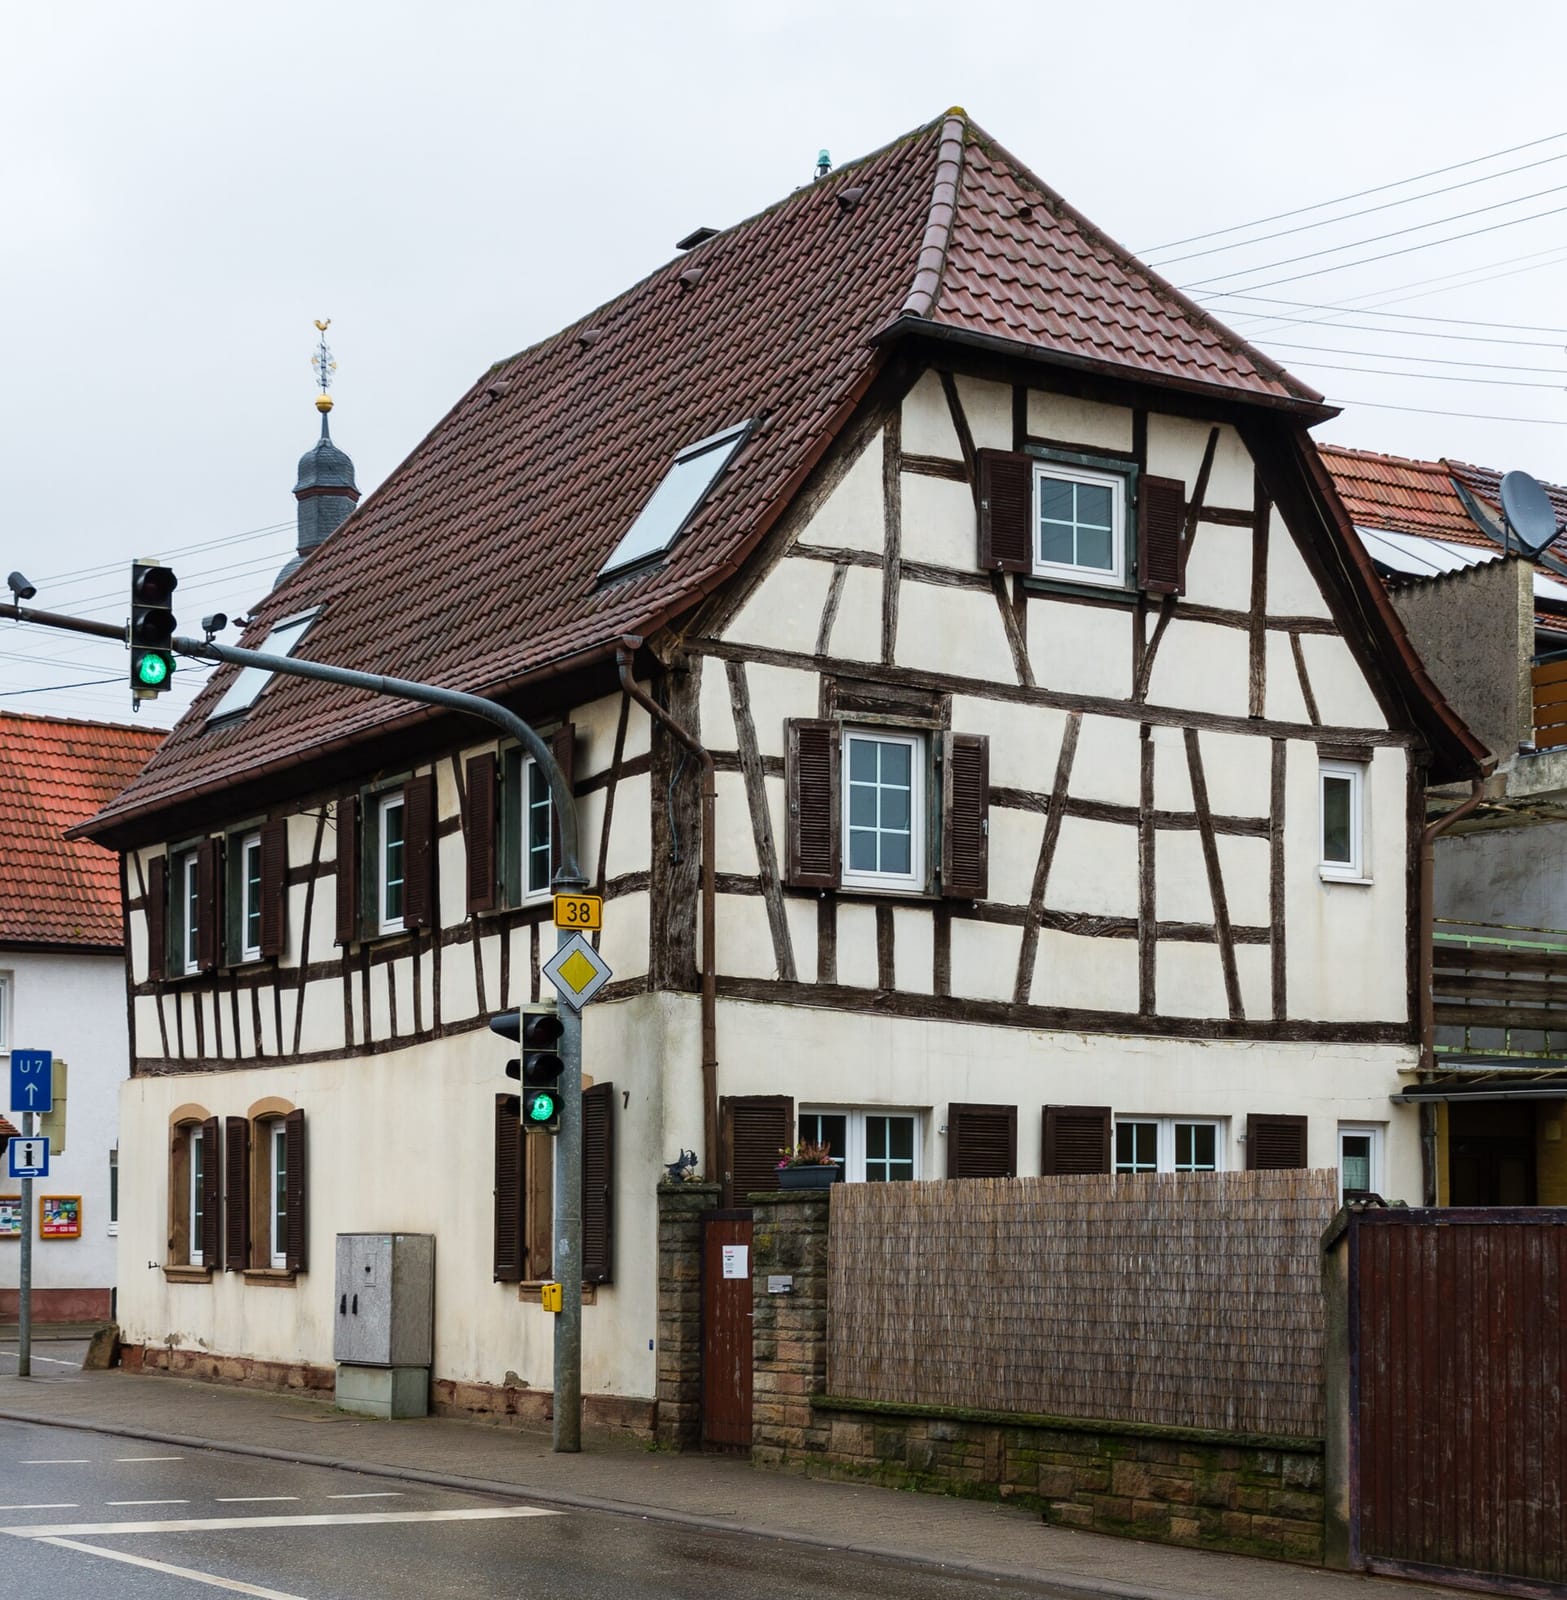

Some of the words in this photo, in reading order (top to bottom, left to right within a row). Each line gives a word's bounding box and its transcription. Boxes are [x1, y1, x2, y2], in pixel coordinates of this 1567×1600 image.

[566, 902, 590, 923] 38
[20, 1059, 30, 1073] U
[35, 1060, 43, 1074] 7
[622, 1091, 630, 1109] 7
[24, 1142, 34, 1166] i
